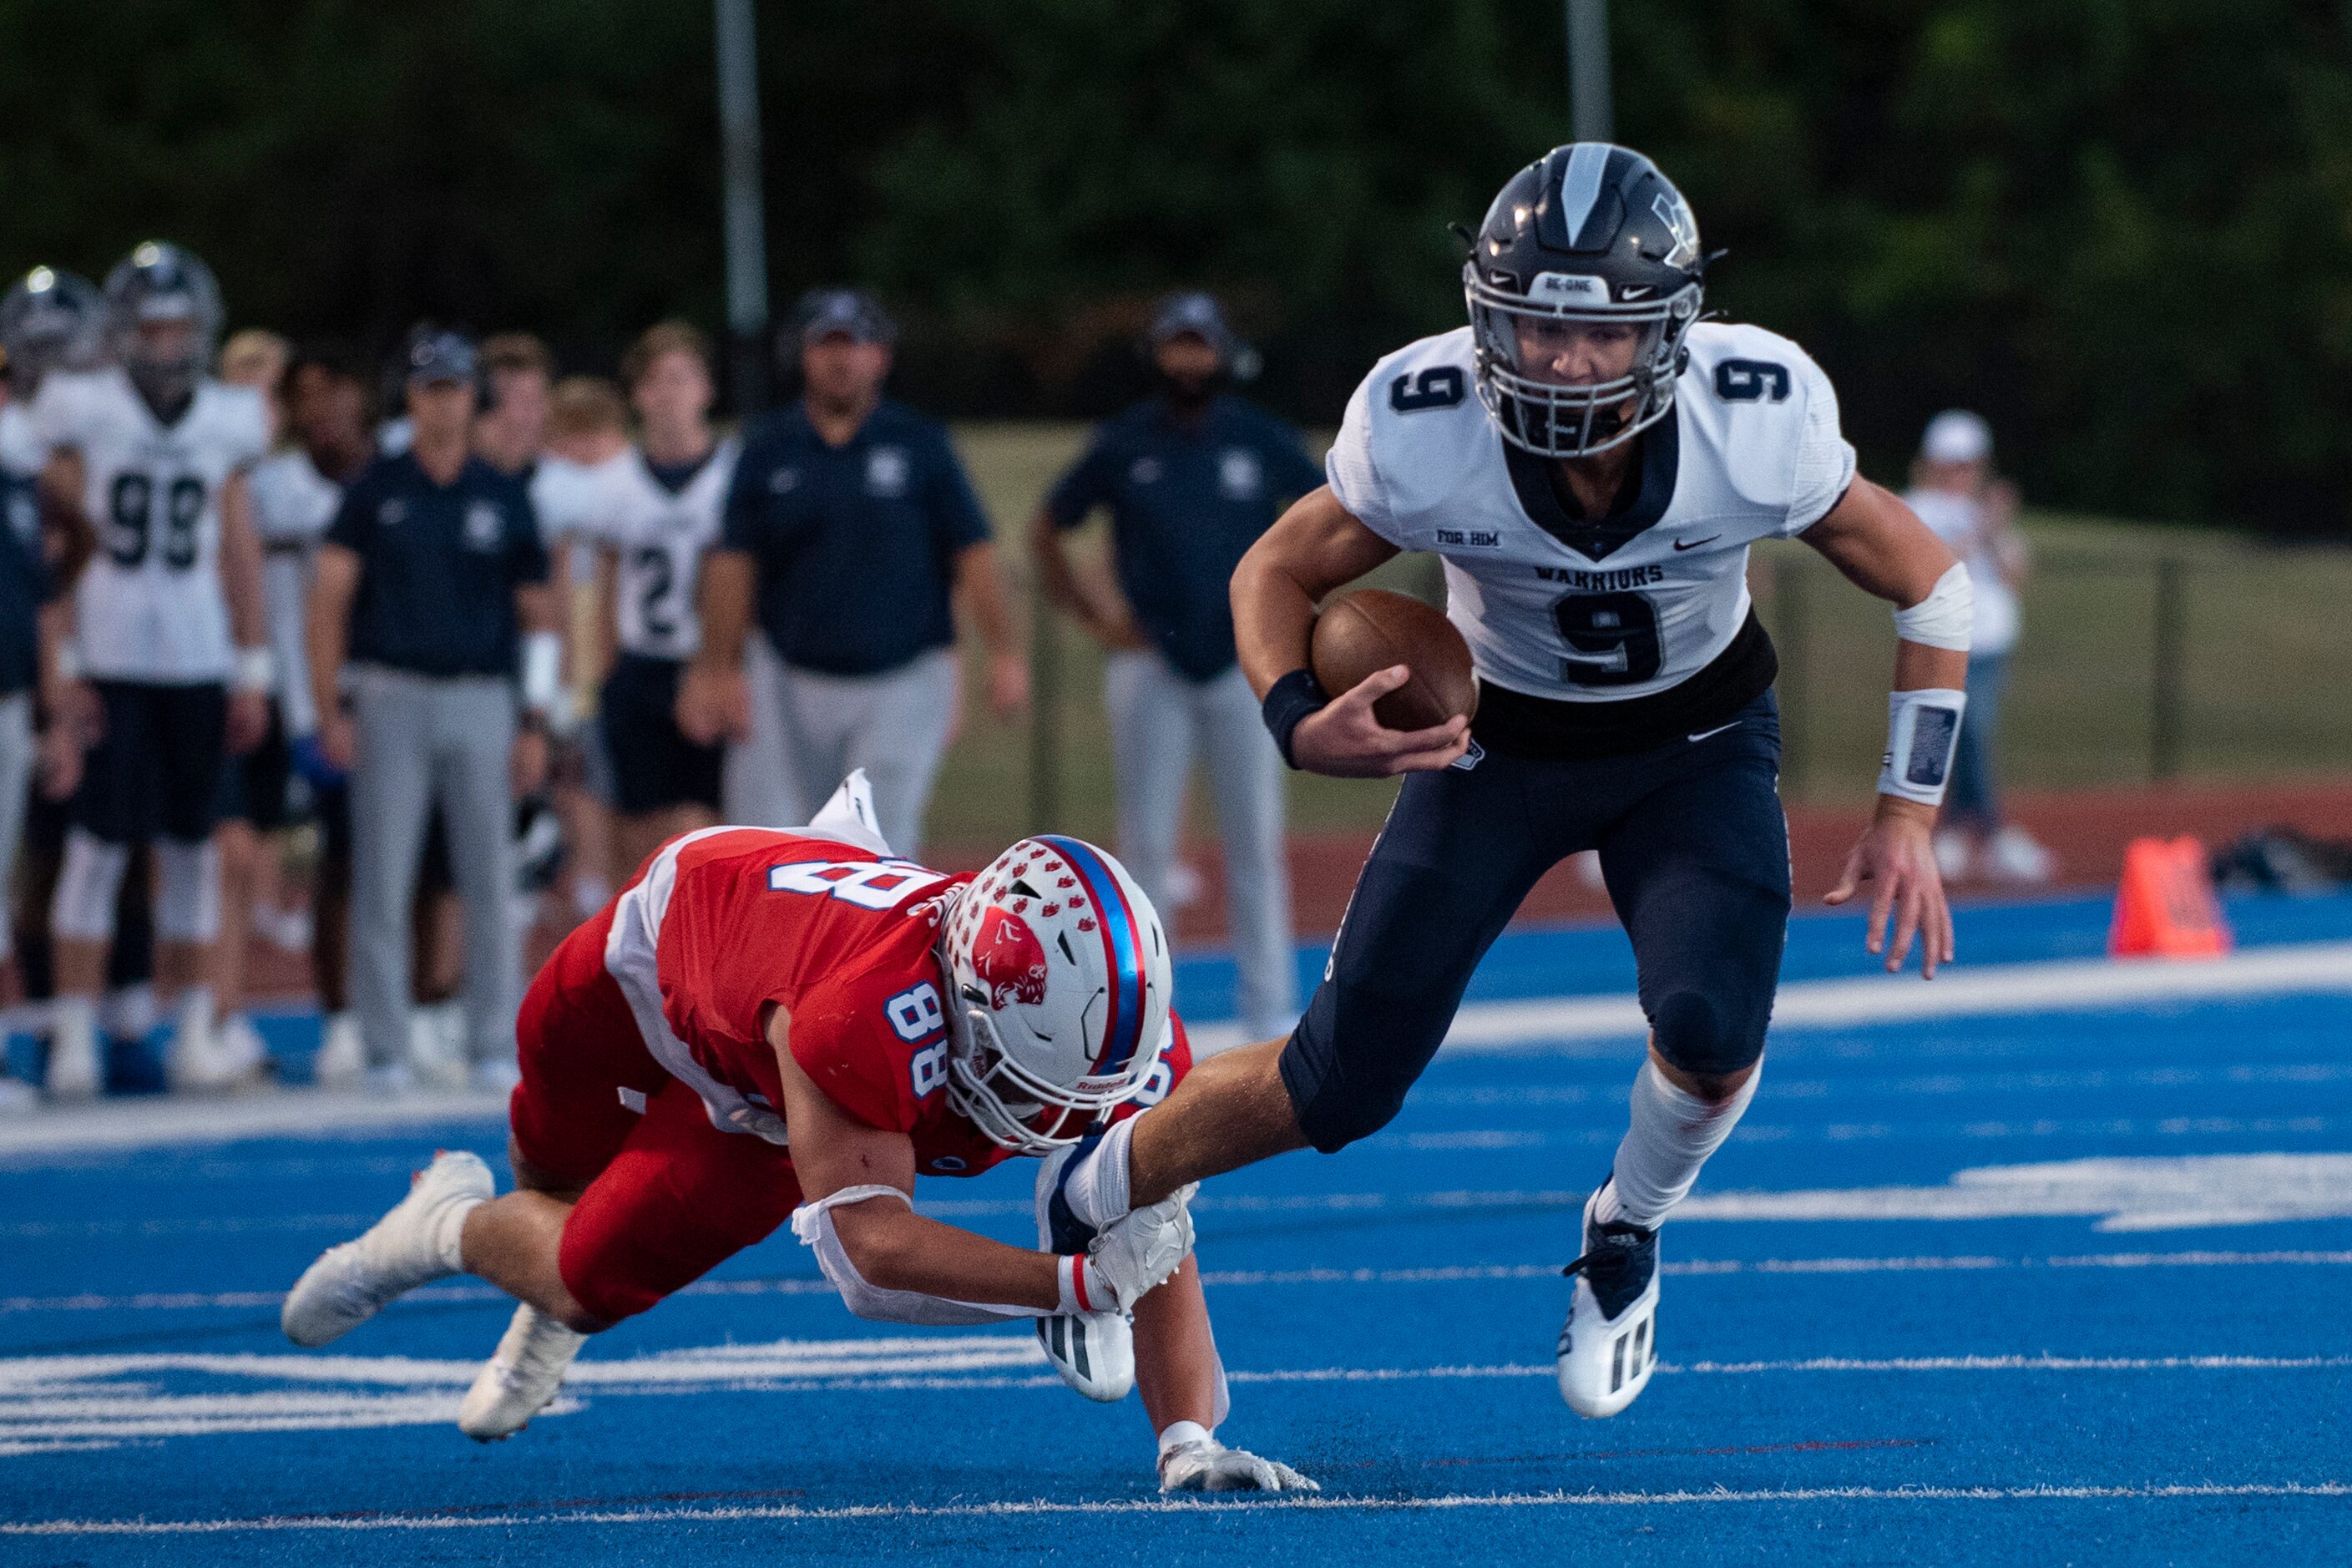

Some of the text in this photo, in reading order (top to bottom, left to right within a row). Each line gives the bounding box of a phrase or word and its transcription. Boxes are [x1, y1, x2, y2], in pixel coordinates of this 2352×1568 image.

[1390, 365, 1466, 415] 9
[1712, 357, 1791, 404] 9
[109, 473, 207, 571] 99
[1437, 529, 1500, 546] FOR HIM
[1534, 564, 1664, 590] WARRIORS
[1549, 589, 1667, 689] 9
[883, 980, 948, 1099] 88
